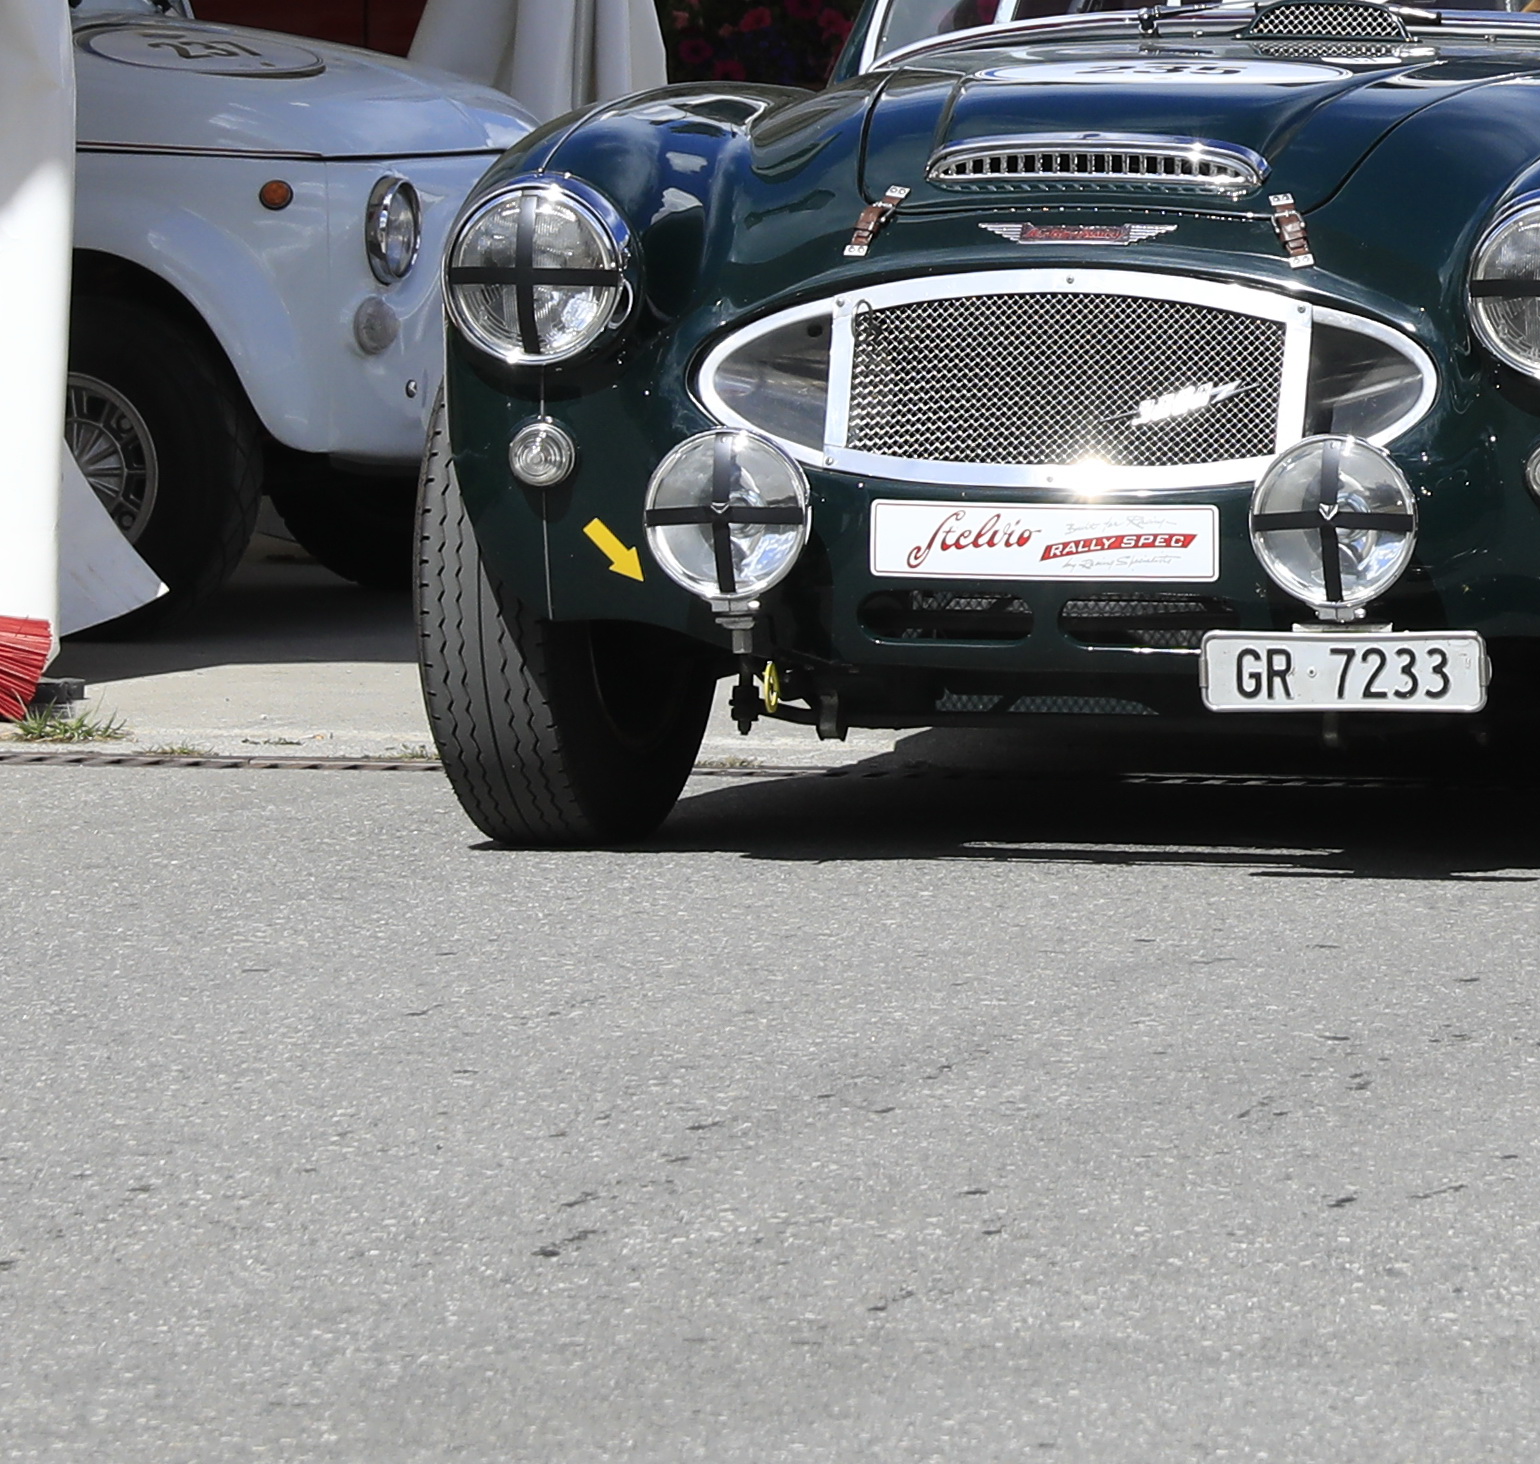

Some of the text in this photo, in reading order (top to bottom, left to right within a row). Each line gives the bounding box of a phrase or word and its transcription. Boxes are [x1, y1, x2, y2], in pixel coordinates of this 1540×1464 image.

[147, 40, 263, 59] 237
[1075, 65, 1248, 75] 235
[1049, 534, 1184, 557] RALLY SPEC
[1236, 647, 1451, 699] GR 7233
